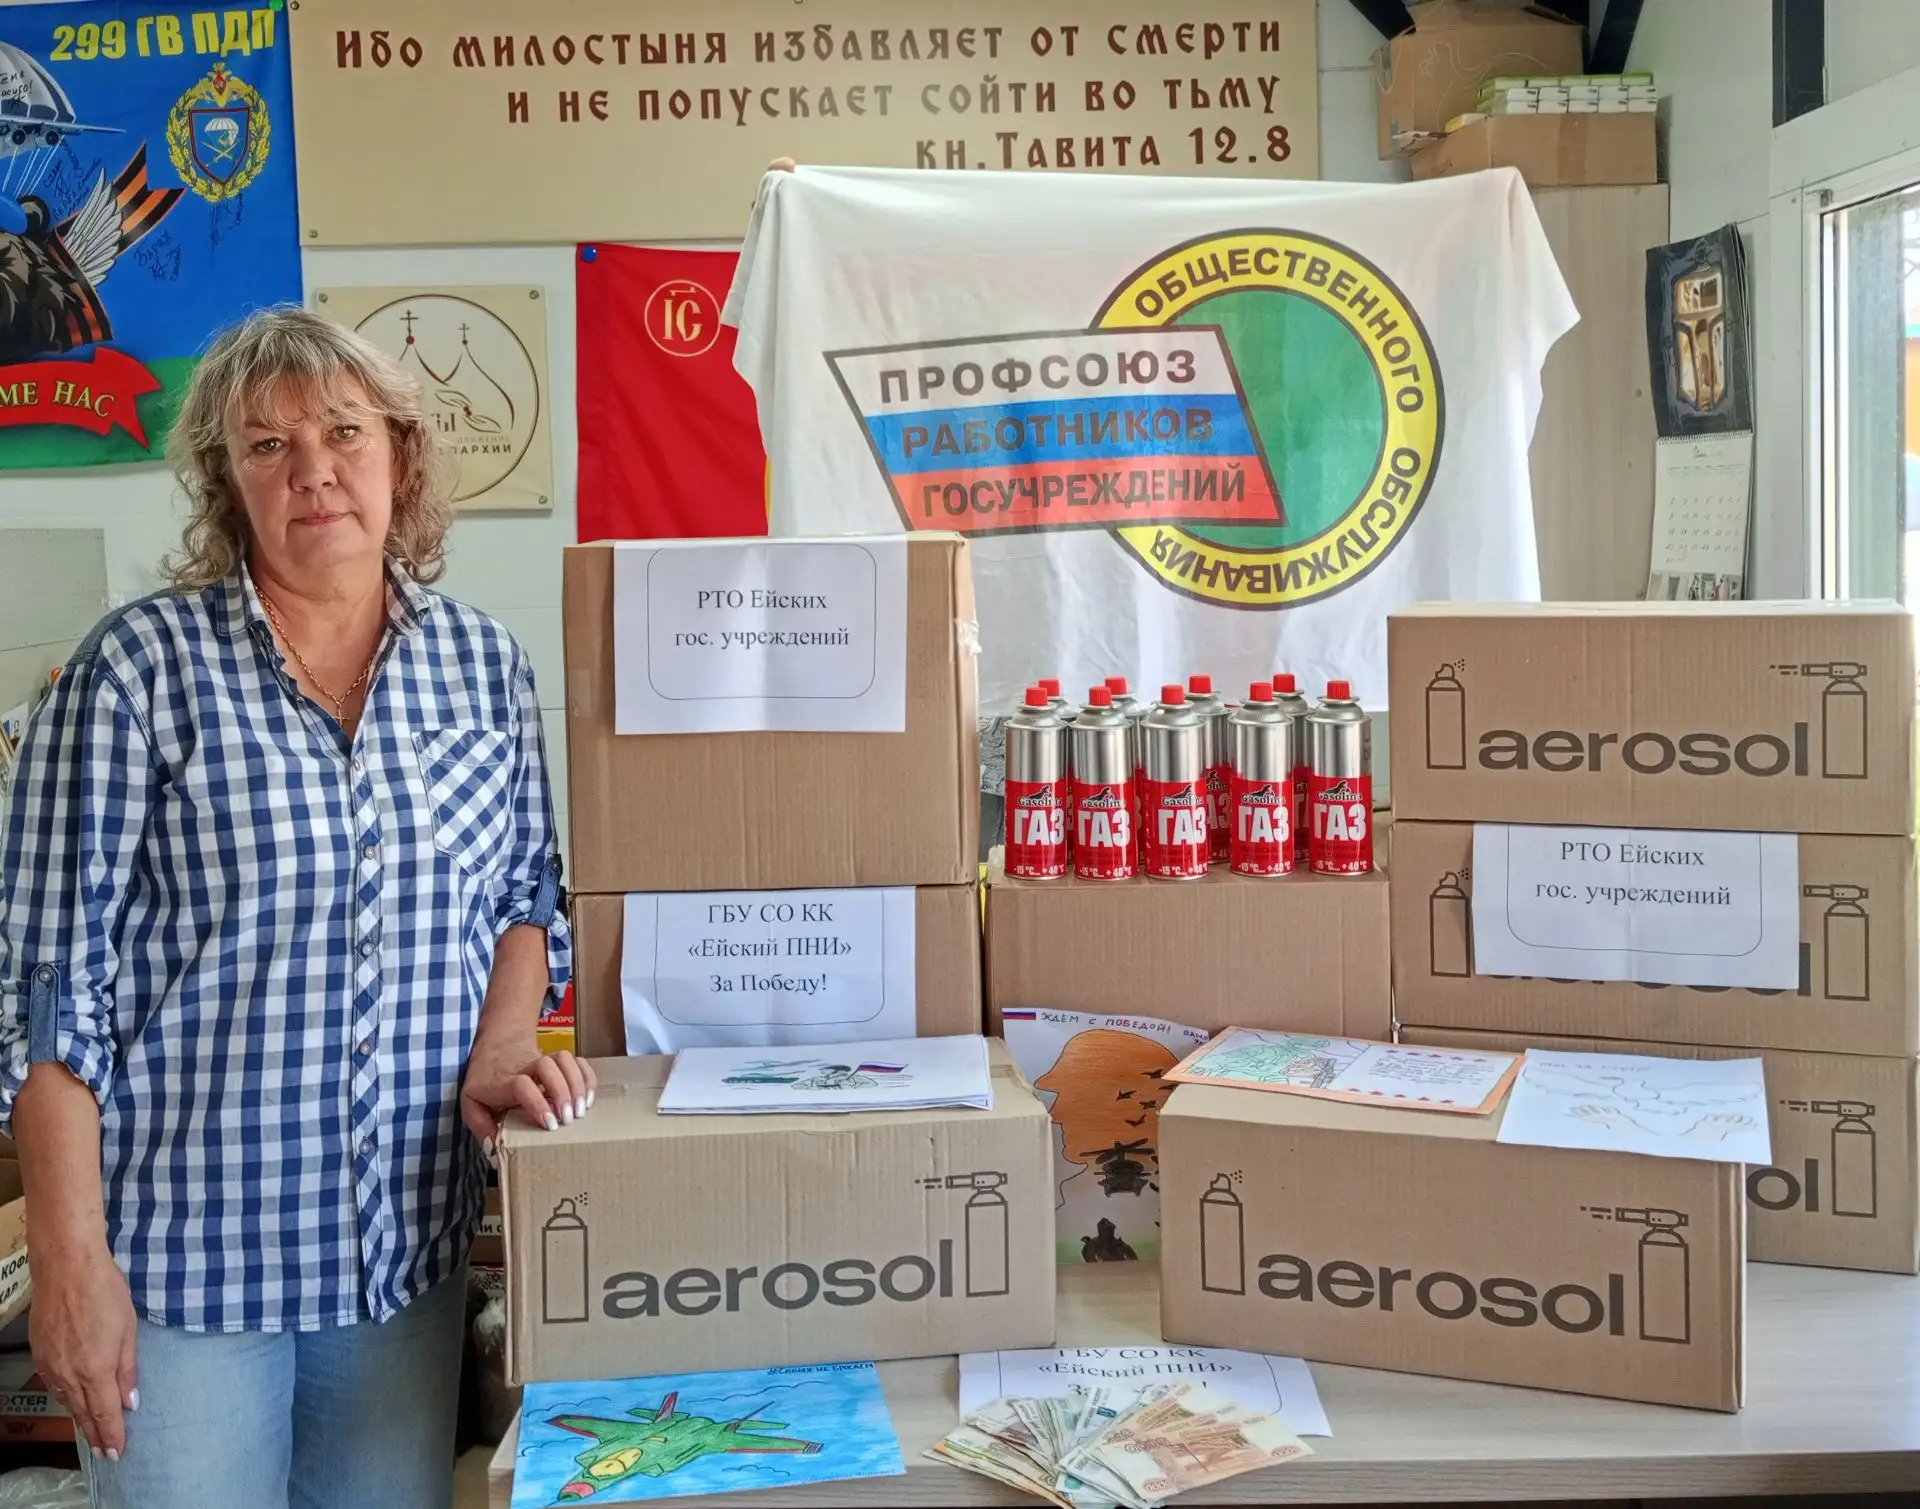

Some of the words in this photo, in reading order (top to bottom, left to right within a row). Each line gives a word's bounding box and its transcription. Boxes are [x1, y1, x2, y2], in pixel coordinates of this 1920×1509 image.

[50, 20, 126, 61] 299
[136, 15, 183, 57] ГВ
[193, 8, 276, 56] ПДП
[336, 31, 423, 68] Ибо
[453, 32, 727, 68] милостыня
[754, 24, 1002, 64] избавляет
[1031, 26, 1079, 56] от
[1107, 21, 1281, 60] смерти
[508, 91, 529, 123] и
[559, 90, 609, 122] не
[638, 84, 893, 126] попускает
[921, 74, 1056, 115] сойти
[1085, 80, 1136, 112] во
[1163, 75, 1281, 114] тьму
[1188, 125, 1292, 164] 12.8
[1135, 247, 1424, 414] ОБЩЕСТВЕННОГО
[880, 350, 1196, 403] ПРОФСОЮЗ
[53, 380, 115, 417] НАС
[903, 406, 1214, 459] РАБОТНИКОВ
[923, 462, 1246, 517] ГОСУЧРЕЖДЕНИЙ
[1149, 448, 1421, 594] ОБСЛУЖИВАНИЯ
[697, 590, 744, 610] РТО
[750, 589, 828, 610] Ейских
[675, 632, 714, 647] гос.
[721, 626, 850, 651] учреждений
[1477, 721, 1810, 778] aerosol
[1014, 808, 1064, 846] ГАЗ
[1078, 809, 1131, 847] ГАЗ
[1158, 807, 1207, 846] ГАЗ
[1238, 806, 1289, 843] ГАЗ
[1314, 803, 1366, 841] ГАЗ
[1560, 841, 1612, 863] РТО
[1619, 842, 1706, 867] Ейских
[1535, 881, 1578, 900] гос.
[1585, 882, 1732, 907] учреждений
[707, 904, 752, 924] ГБУ
[759, 903, 795, 924] СО
[802, 903, 834, 923] КК
[688, 937, 779, 958] «Ейский
[785, 936, 853, 957] ПНИ»
[710, 974, 733, 993] За
[741, 972, 827, 997] Победу!
[1105, 1018, 1171, 1035] ПОБЕДОЙ!
[602, 1238, 954, 1321] aerosol
[1256, 1252, 1625, 1336] aerosol
[1038, 1361, 1145, 1378] «Ейский
[1154, 1362, 1233, 1374] ПНИ»
